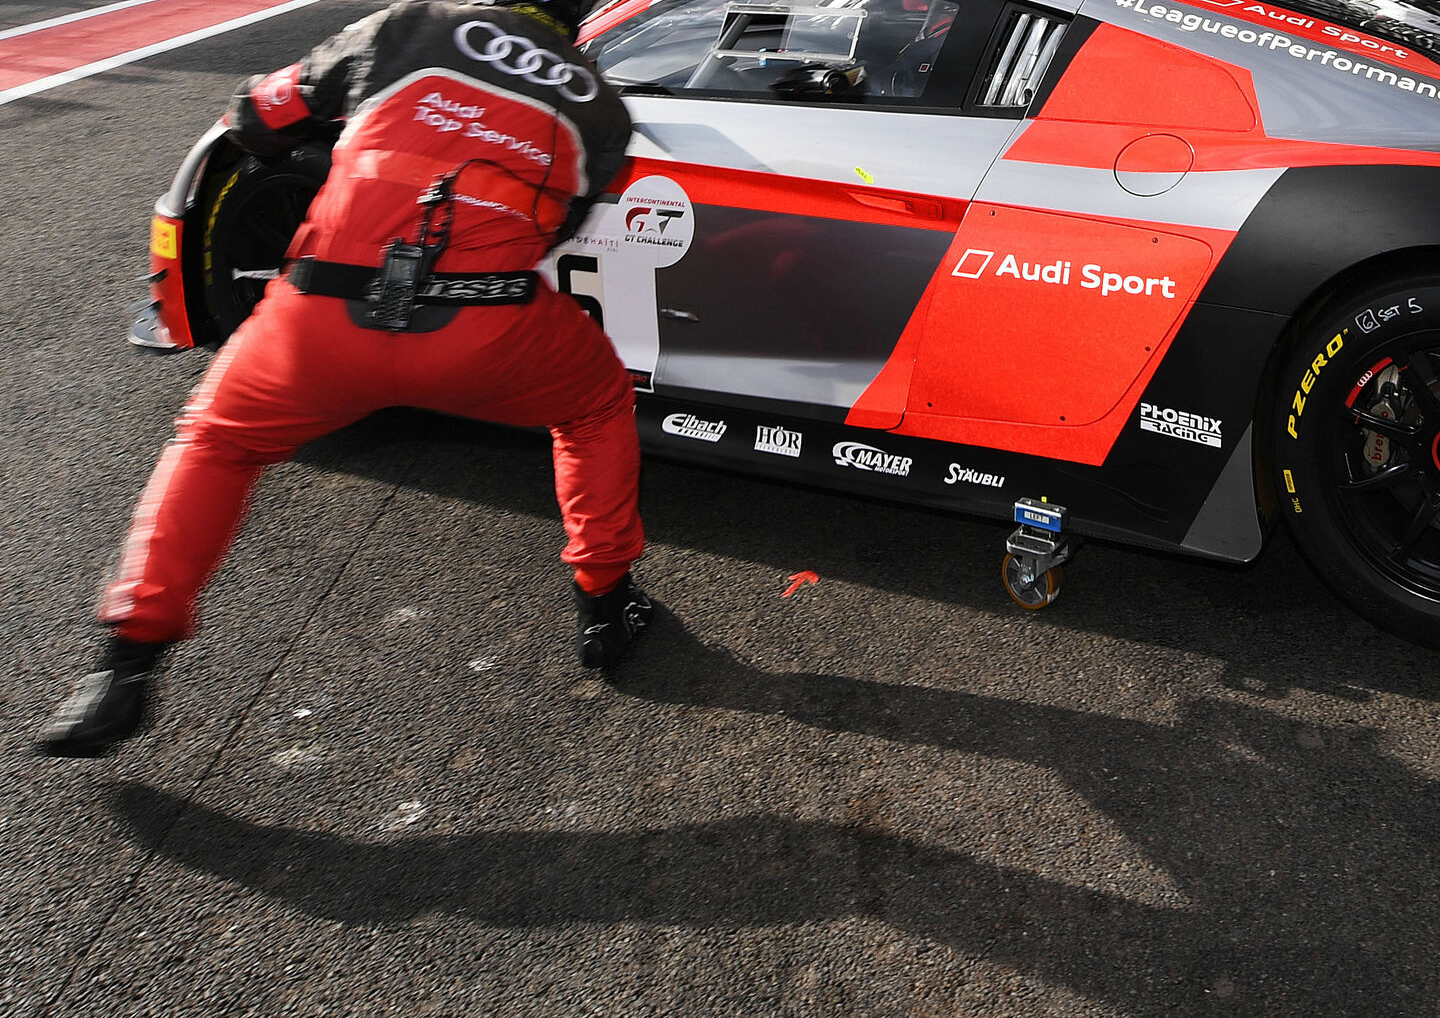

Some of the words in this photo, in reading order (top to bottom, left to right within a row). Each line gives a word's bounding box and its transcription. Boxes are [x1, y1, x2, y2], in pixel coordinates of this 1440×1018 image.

[1243, 4, 1314, 29] Audi
[1321, 24, 1409, 59] Sport
[416, 92, 486, 119] Audi
[413, 105, 463, 132] Top
[463, 122, 552, 166] Service
[624, 233, 636, 243] GT
[636, 234, 684, 248] CHALLENGE
[995, 254, 1071, 285] Audi
[1080, 264, 1176, 299] Sport
[1407, 297, 1423, 314] 5
[1287, 333, 1344, 440] PZERO
[662, 413, 728, 437] Eibach
[758, 425, 800, 450] HÖR
[856, 450, 913, 472] MAYER
[943, 463, 1005, 488] STÄUBLI
